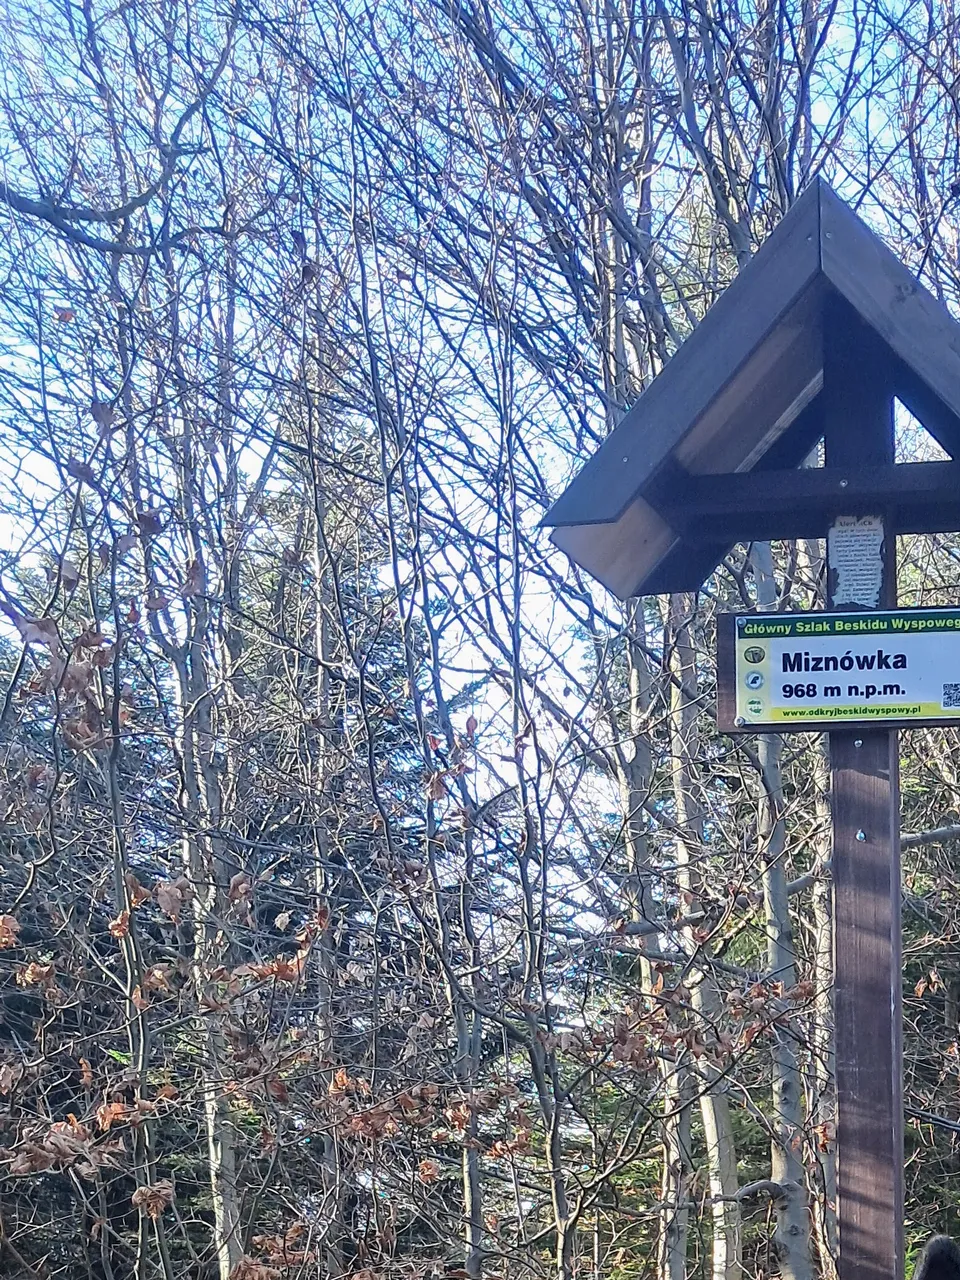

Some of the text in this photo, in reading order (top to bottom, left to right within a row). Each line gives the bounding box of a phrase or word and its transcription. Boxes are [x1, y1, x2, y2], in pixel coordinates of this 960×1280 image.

[744, 622, 792, 635] Główny
[796, 622, 830, 632] Szlak
[835, 620, 888, 631] Beskidu
[782, 650, 908, 672] Miznówka
[782, 682, 906, 700] 968 m n.p.m.
[782, 706, 922, 718] www.odkryjbeskidwyspowy.pl
